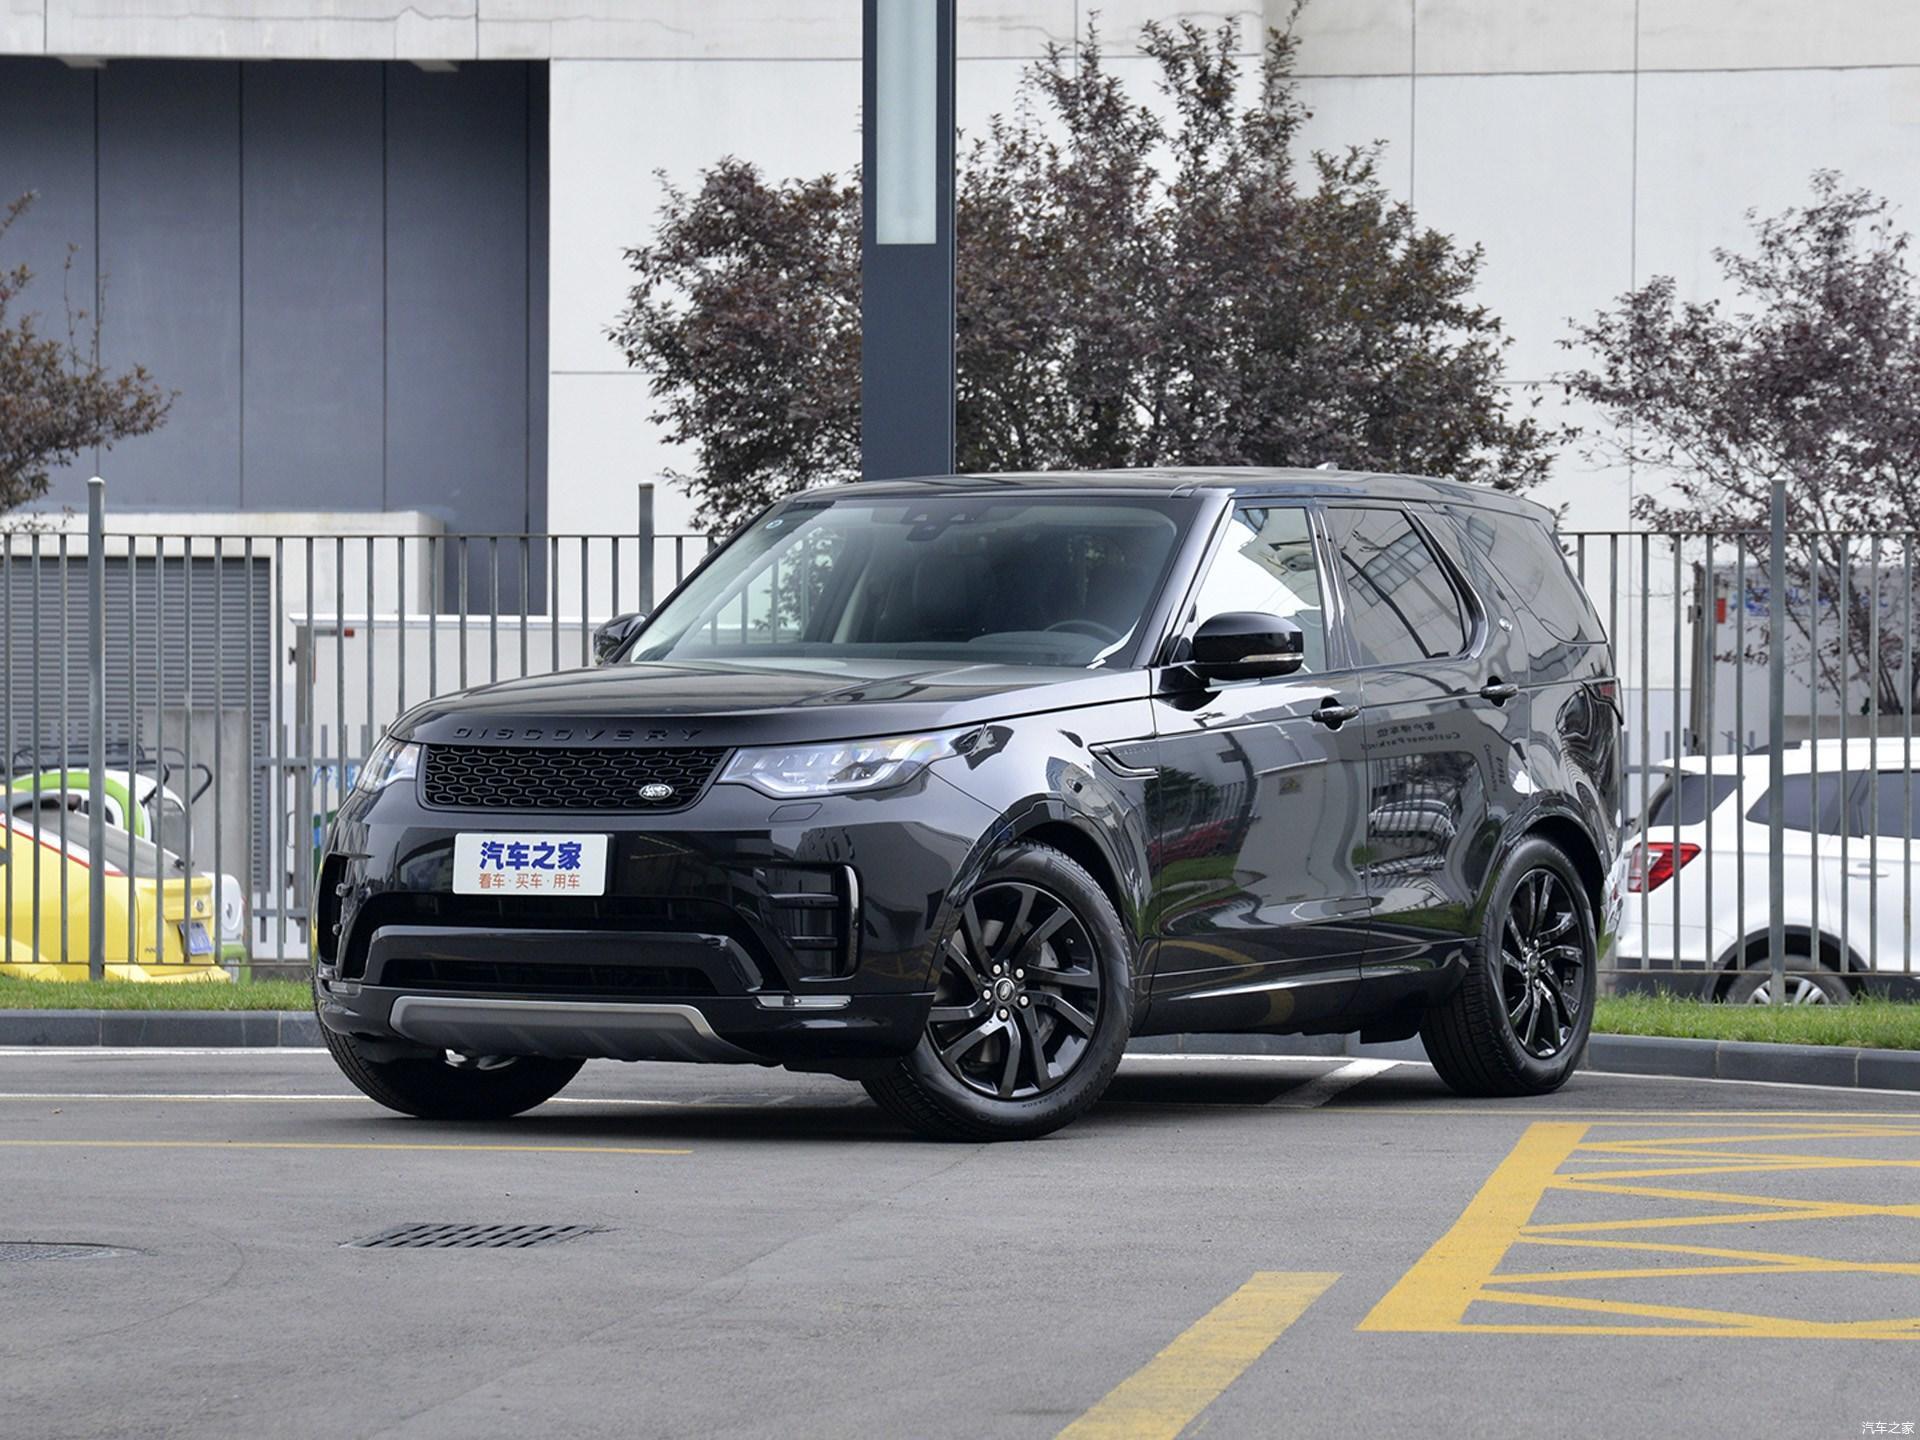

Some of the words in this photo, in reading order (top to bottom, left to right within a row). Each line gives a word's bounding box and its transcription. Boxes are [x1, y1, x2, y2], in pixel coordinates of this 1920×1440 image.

[453, 727, 703, 741] DISCOVERY
[479, 841, 583, 870] 汽车之家
